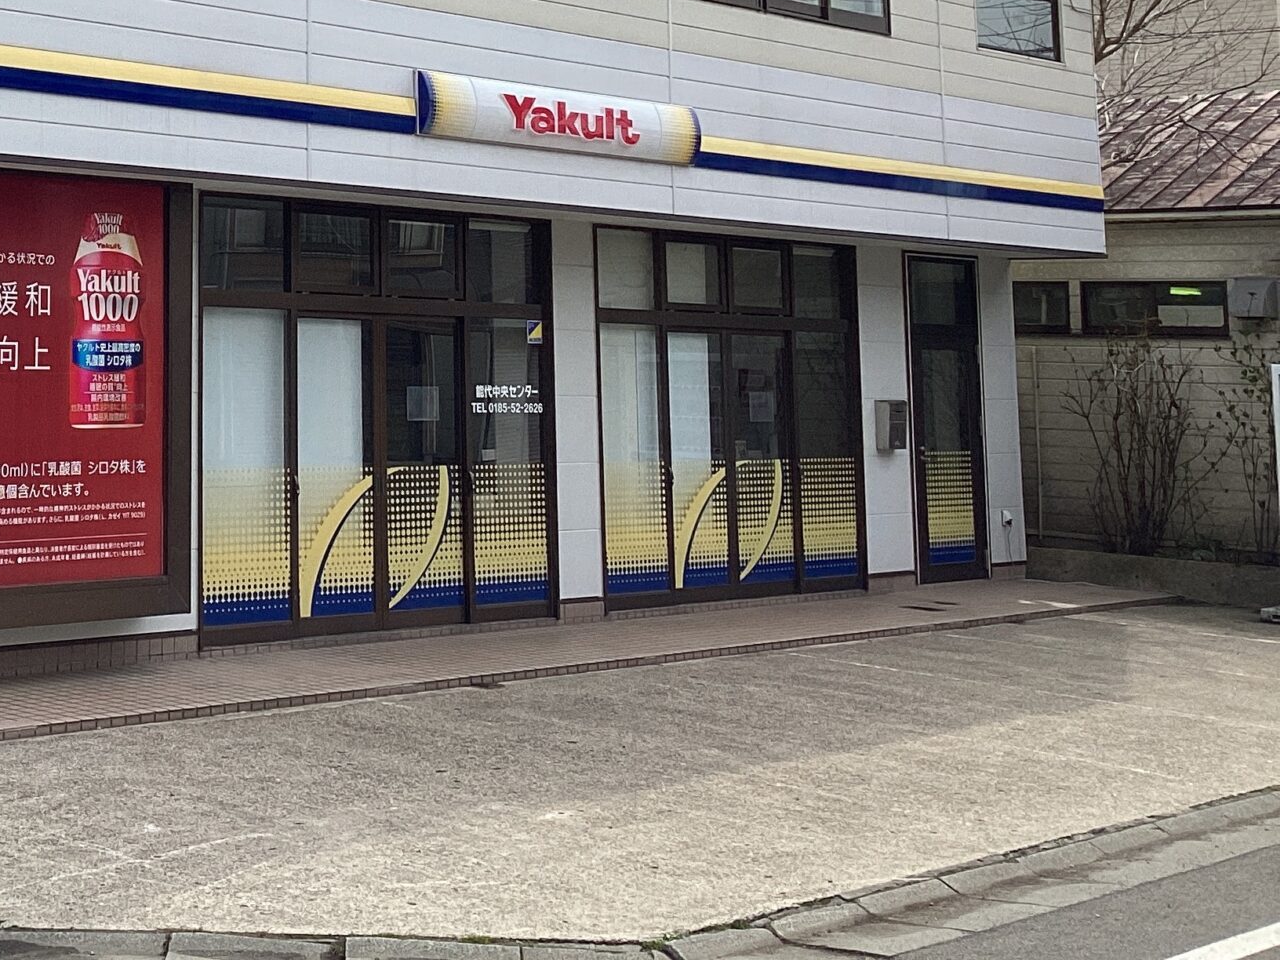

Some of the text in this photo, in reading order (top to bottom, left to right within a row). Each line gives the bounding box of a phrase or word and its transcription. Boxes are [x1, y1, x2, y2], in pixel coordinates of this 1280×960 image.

[503, 93, 641, 146] Yakult
[94, 212, 123, 225] Yakult
[77, 268, 140, 293] Yakult
[78, 293, 139, 322] 1000
[475, 385, 539, 398] 能代中央センター
[471, 402, 544, 413] TEL 0185-52-2626
